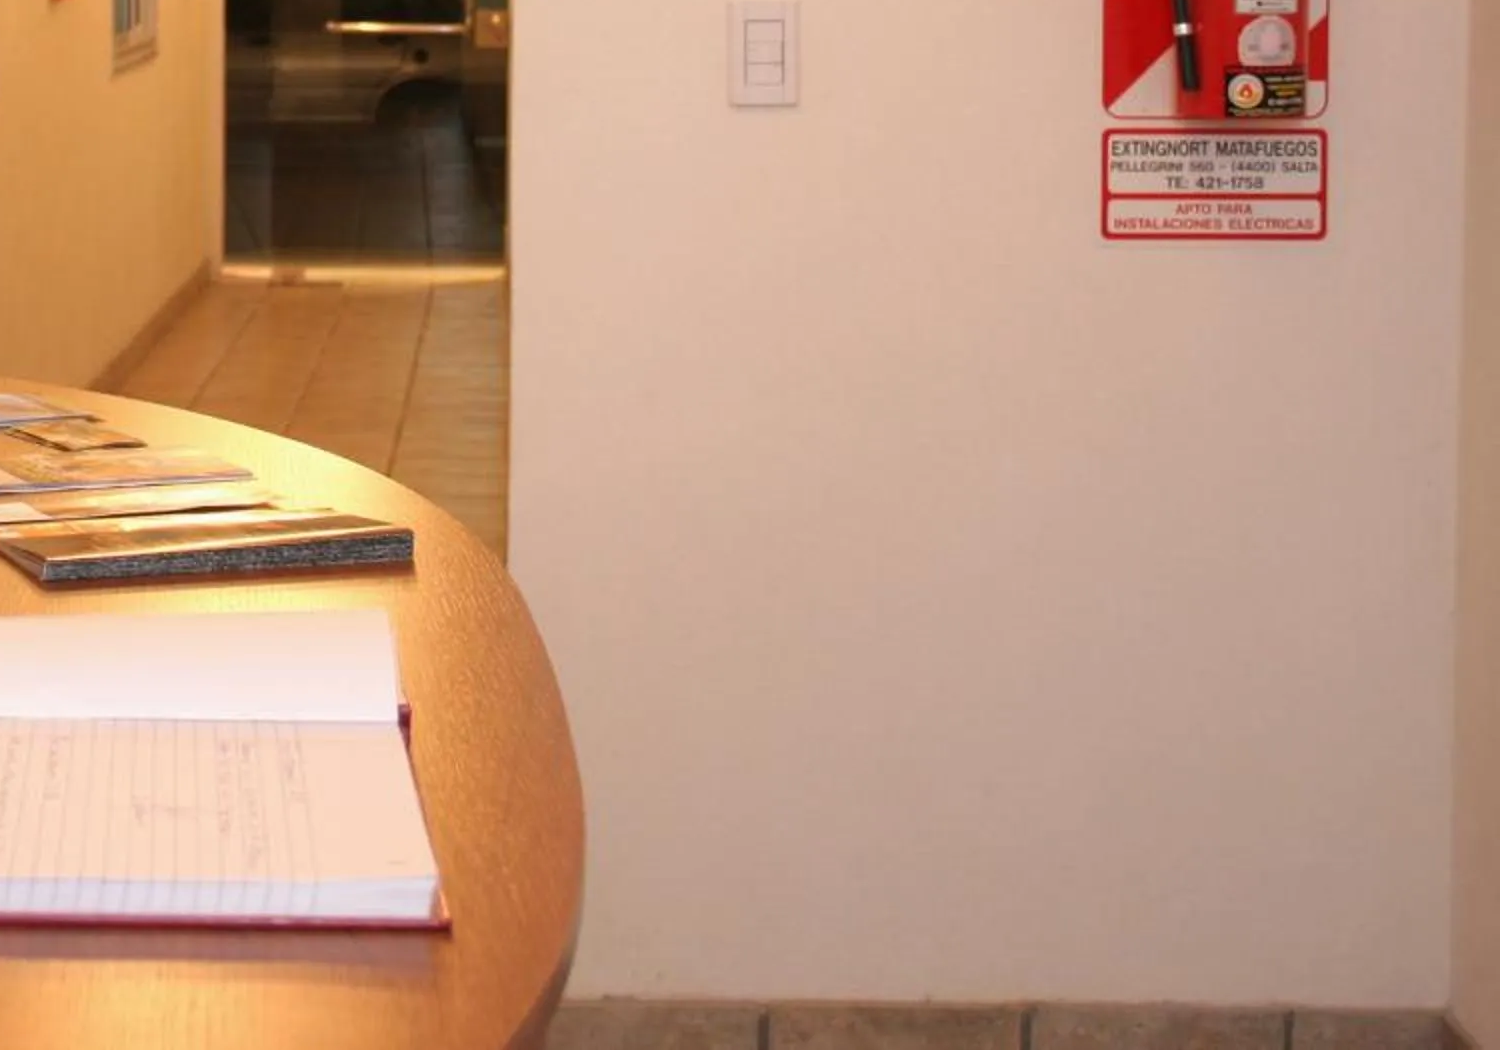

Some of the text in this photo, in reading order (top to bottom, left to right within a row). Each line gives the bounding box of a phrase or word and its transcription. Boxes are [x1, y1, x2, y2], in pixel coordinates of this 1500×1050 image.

[1111, 140, 1317, 157] EXTINGNORT MATAFUEGOS
[1111, 161, 1183, 173] PELLEGRINI
[1282, 161, 1318, 173] SALTA
[1195, 176, 1264, 189] 421-1758
[1176, 203, 1252, 214] APTO PARA
[1114, 218, 1314, 230] INSTALACIONES ELECTRICAS
